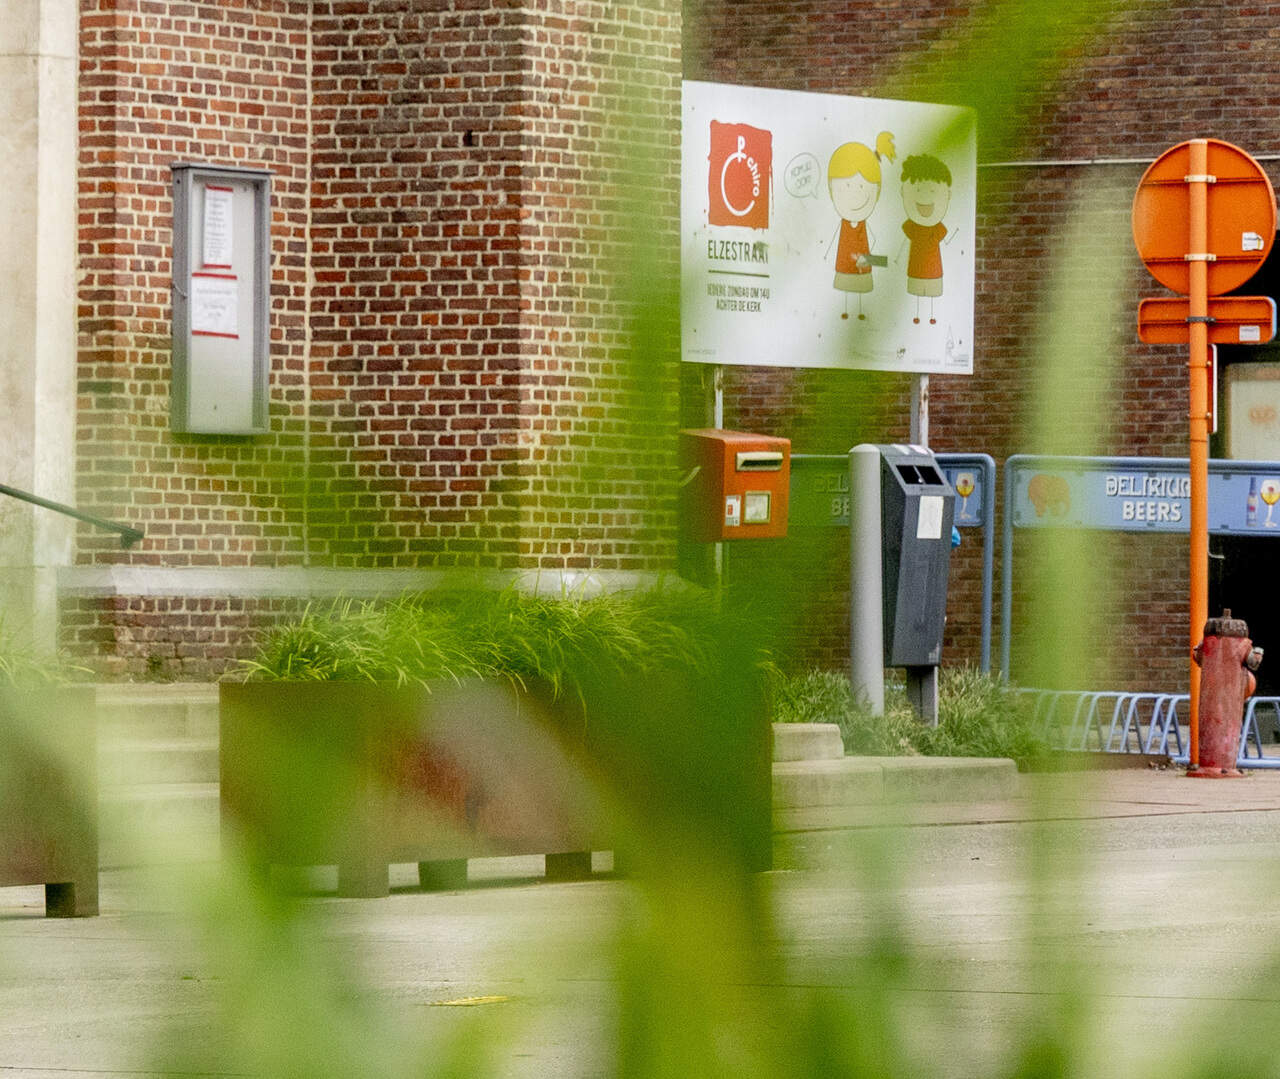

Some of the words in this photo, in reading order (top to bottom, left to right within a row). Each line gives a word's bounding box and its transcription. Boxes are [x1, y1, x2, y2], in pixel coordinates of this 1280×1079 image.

[746, 156, 761, 197] chiro
[716, 299, 738, 312] ACHTER
[738, 300, 746, 312] DE
[746, 301, 762, 313] KERK
[1122, 501, 1182, 522] BEERS
